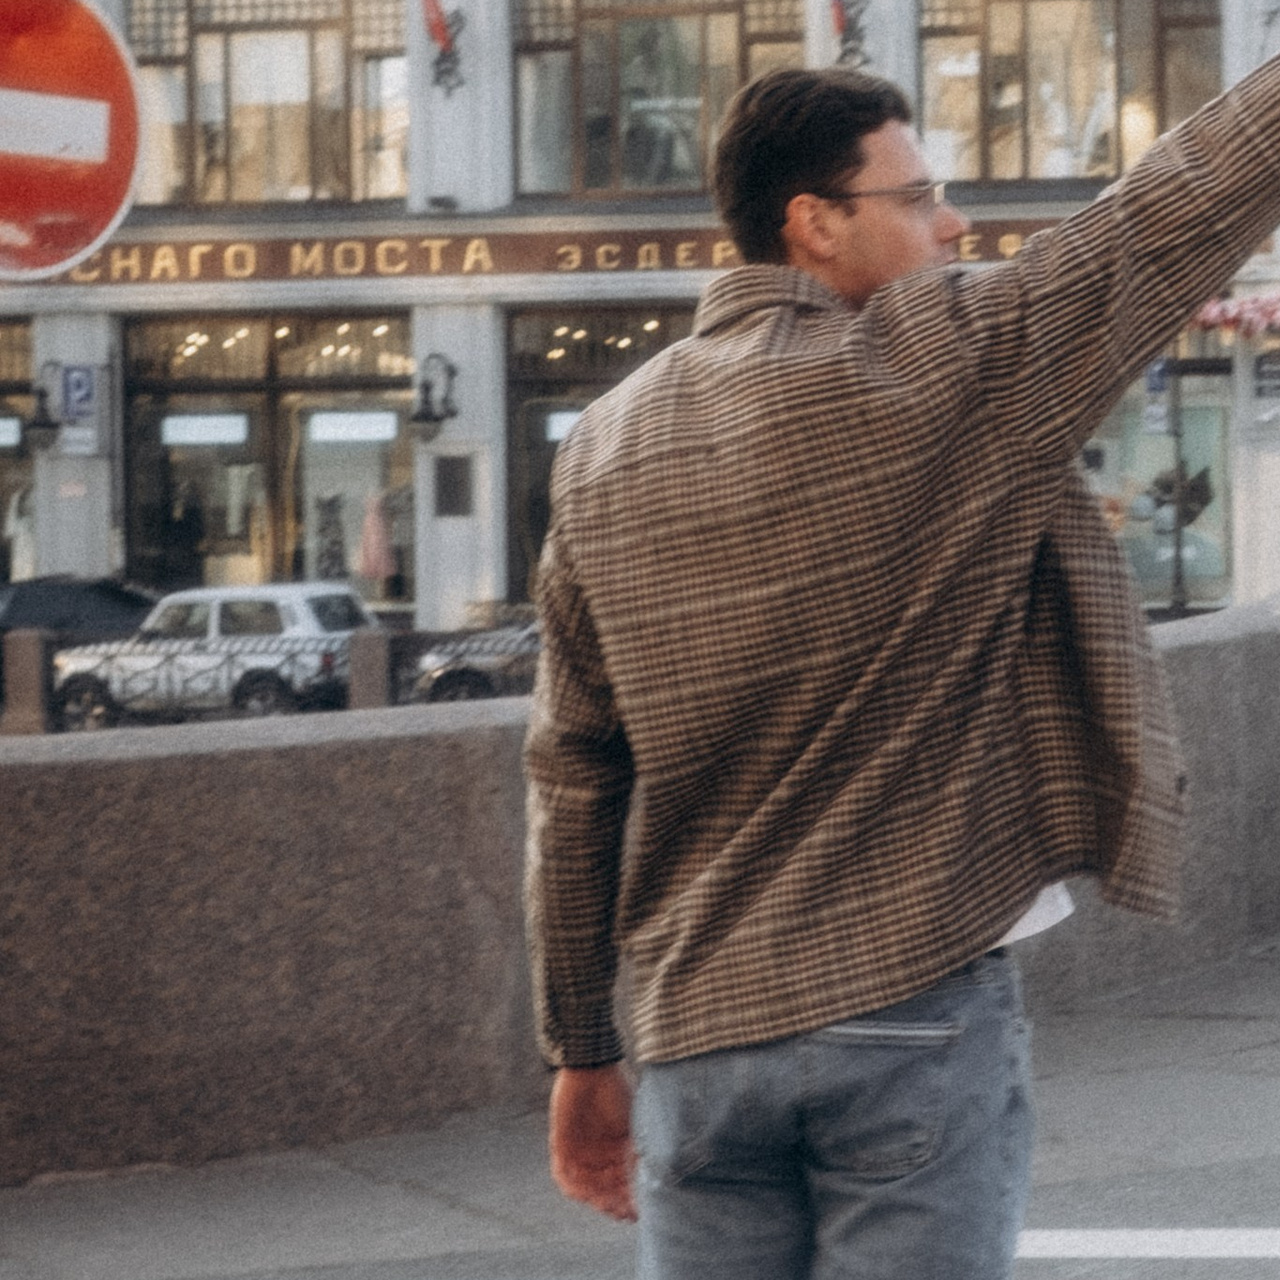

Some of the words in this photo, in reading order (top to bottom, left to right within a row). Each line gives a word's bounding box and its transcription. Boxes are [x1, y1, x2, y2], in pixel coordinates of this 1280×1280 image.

[60, 242, 258, 283] СНАГО
[289, 236, 496, 278] МОСТА
[555, 238, 744, 270] ЭСДЕР
